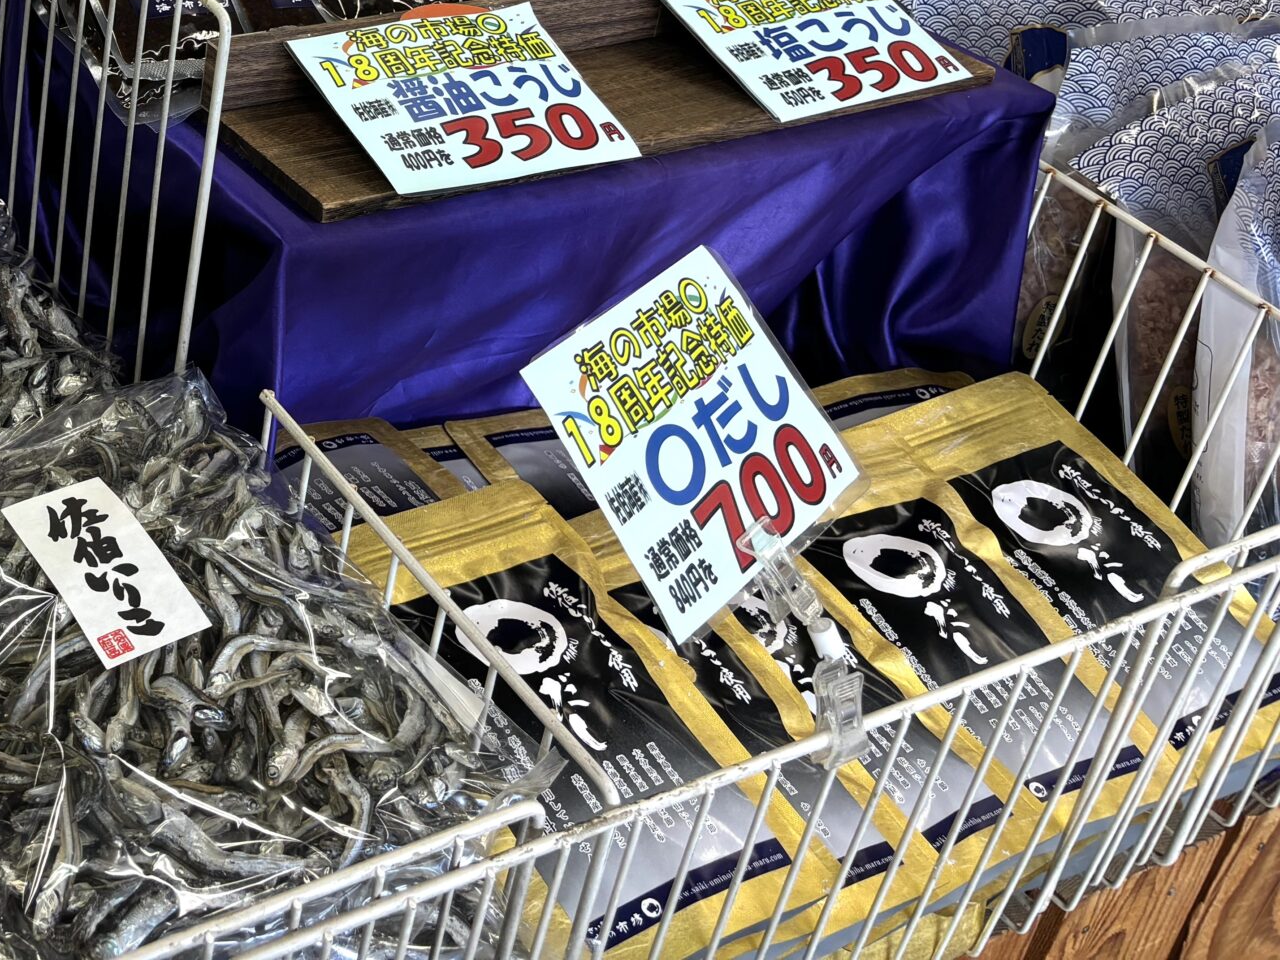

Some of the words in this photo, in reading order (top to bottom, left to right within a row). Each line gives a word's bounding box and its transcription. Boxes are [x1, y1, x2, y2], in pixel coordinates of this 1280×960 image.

[320, 31, 556, 88] 18周年記念特価
[753, 4, 912, 63] 塩こうじ
[387, 63, 583, 123] 醤油こうじ
[759, 68, 814, 92] 通常価格
[780, 86, 826, 108] 450円を
[379, 126, 445, 153] 通常価格
[400, 148, 456, 172] 400円を
[562, 295, 754, 468] 18周年記念特価
[46, 494, 167, 638] 佐伯いりこ
[644, 518, 705, 582] 通常価格
[668, 557, 719, 614] 840円を
[563, 638, 579, 664] MARU
